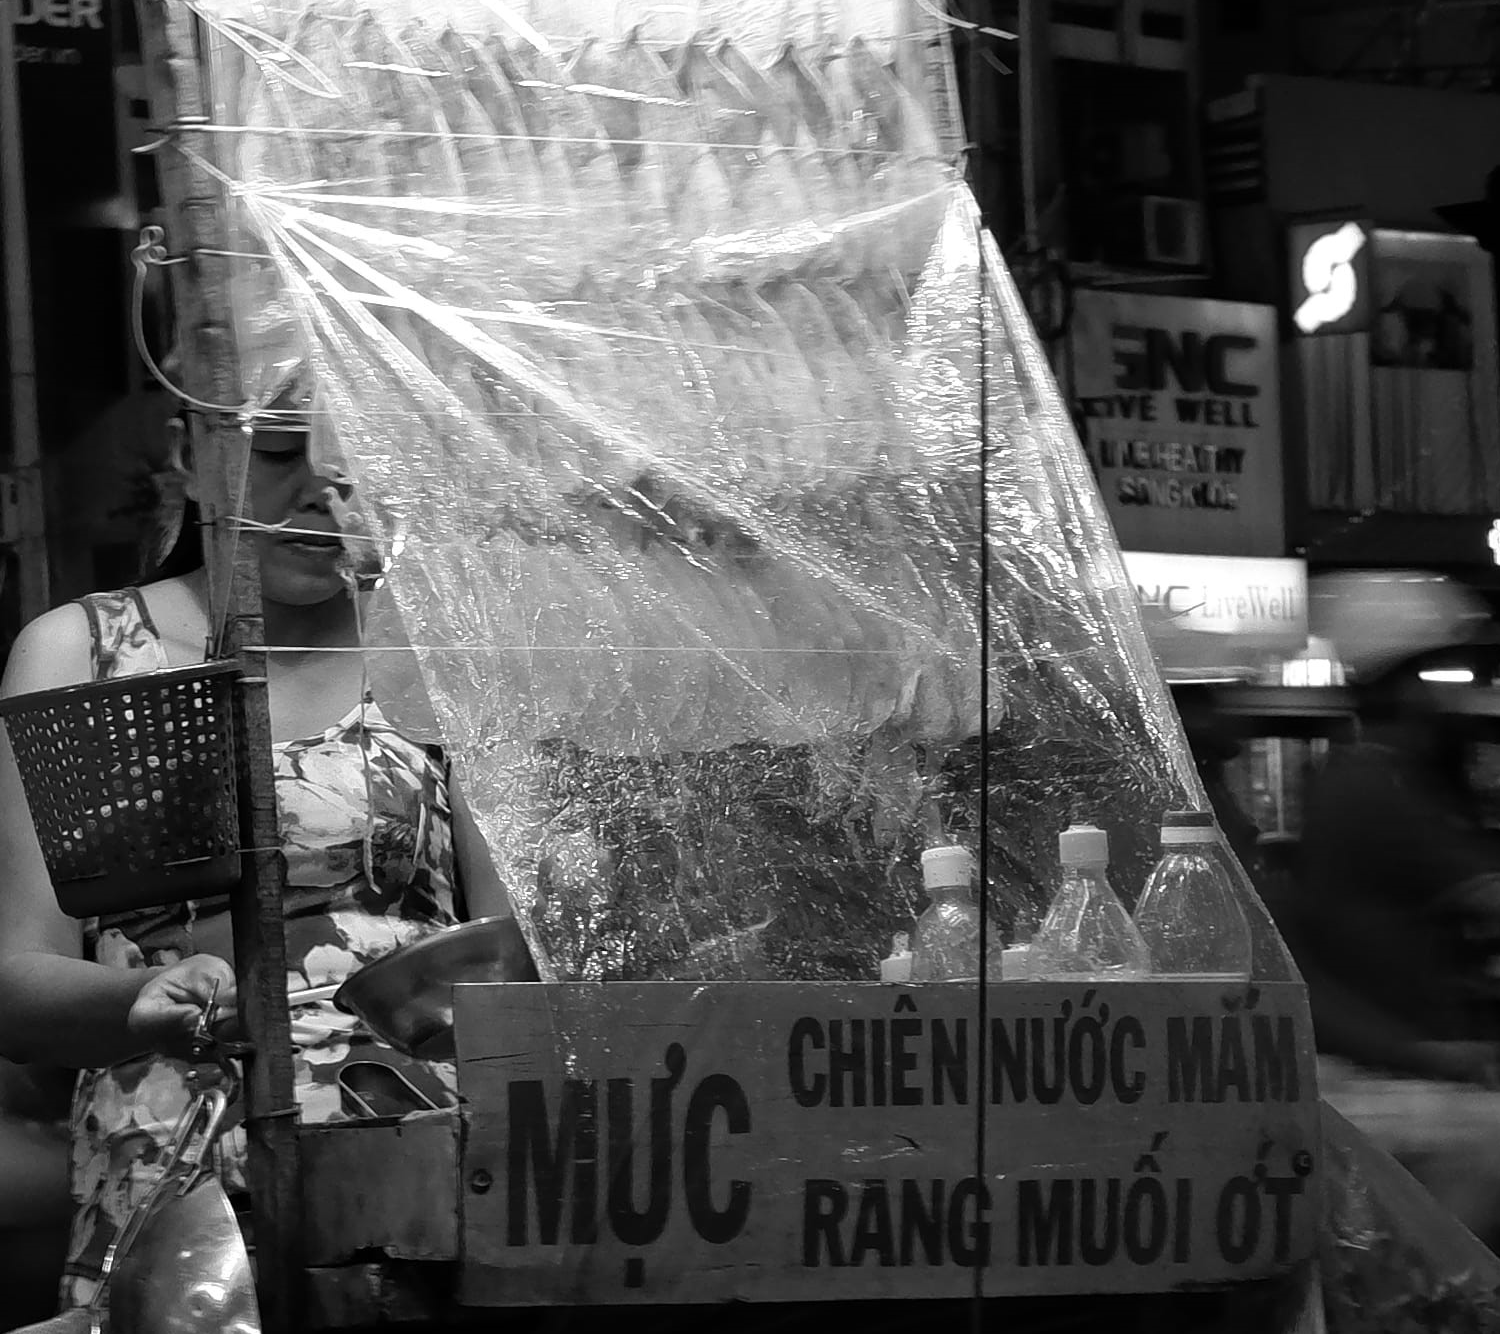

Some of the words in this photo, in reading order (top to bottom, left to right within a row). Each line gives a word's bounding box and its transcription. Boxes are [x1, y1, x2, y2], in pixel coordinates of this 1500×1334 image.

[1174, 397, 1260, 428] WELL
[505, 1041, 753, 1289] MỰC
[787, 992, 972, 1107] CHIÊN
[990, 990, 1148, 1106] NƯỚC
[1166, 988, 1300, 1104] MẮM
[802, 1176, 992, 1268] RANG
[1016, 1131, 1191, 1267] MUỐI
[1216, 1149, 1306, 1264] ỚT
